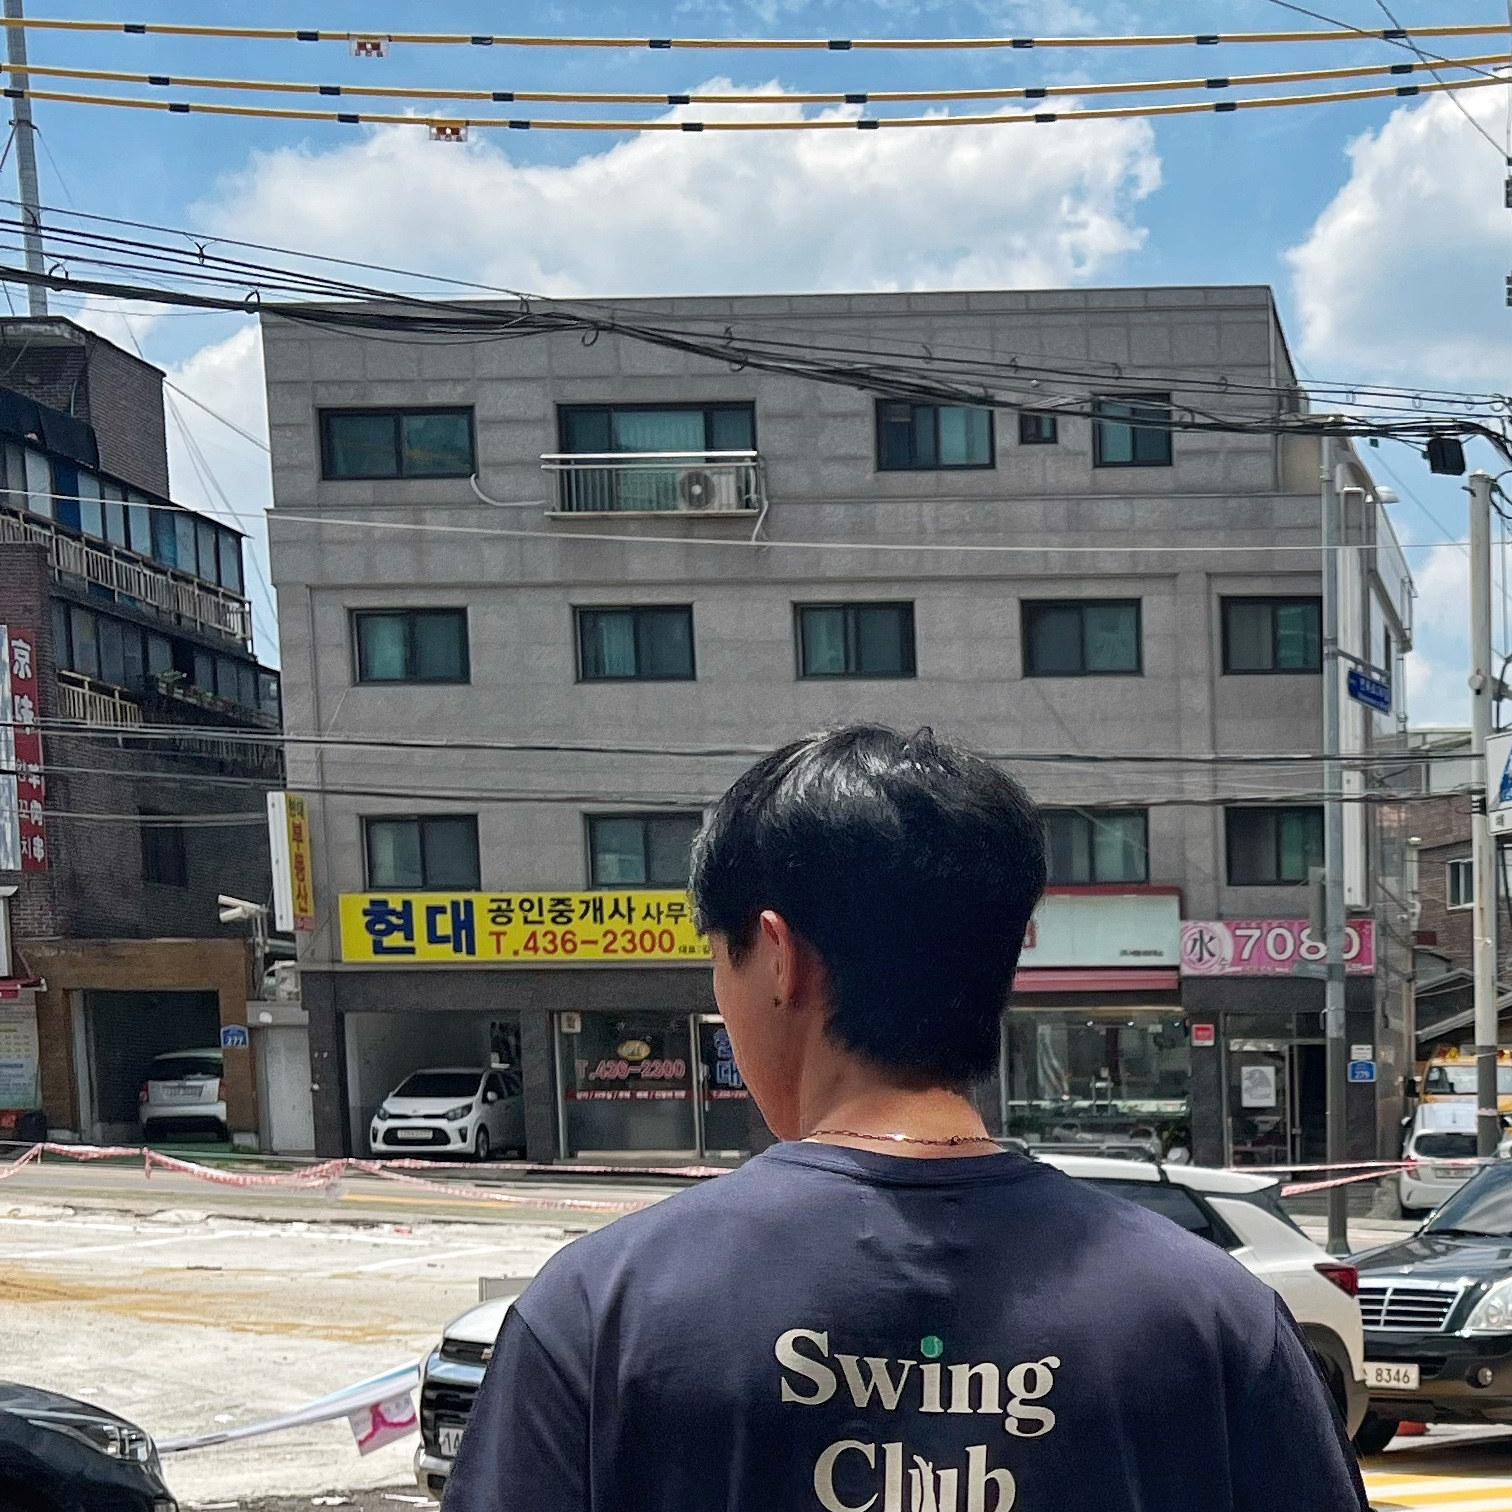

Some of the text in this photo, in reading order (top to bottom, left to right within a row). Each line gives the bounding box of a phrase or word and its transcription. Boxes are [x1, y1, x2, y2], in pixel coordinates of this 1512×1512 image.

[362, 896, 696, 956] 현대 공인중개사 사무
[488, 928, 676, 958] T.436-2300
[1234, 926, 1361, 962] 7080
[1189, 929, 1217, 963] 水
[774, 1328, 1061, 1437] Swing
